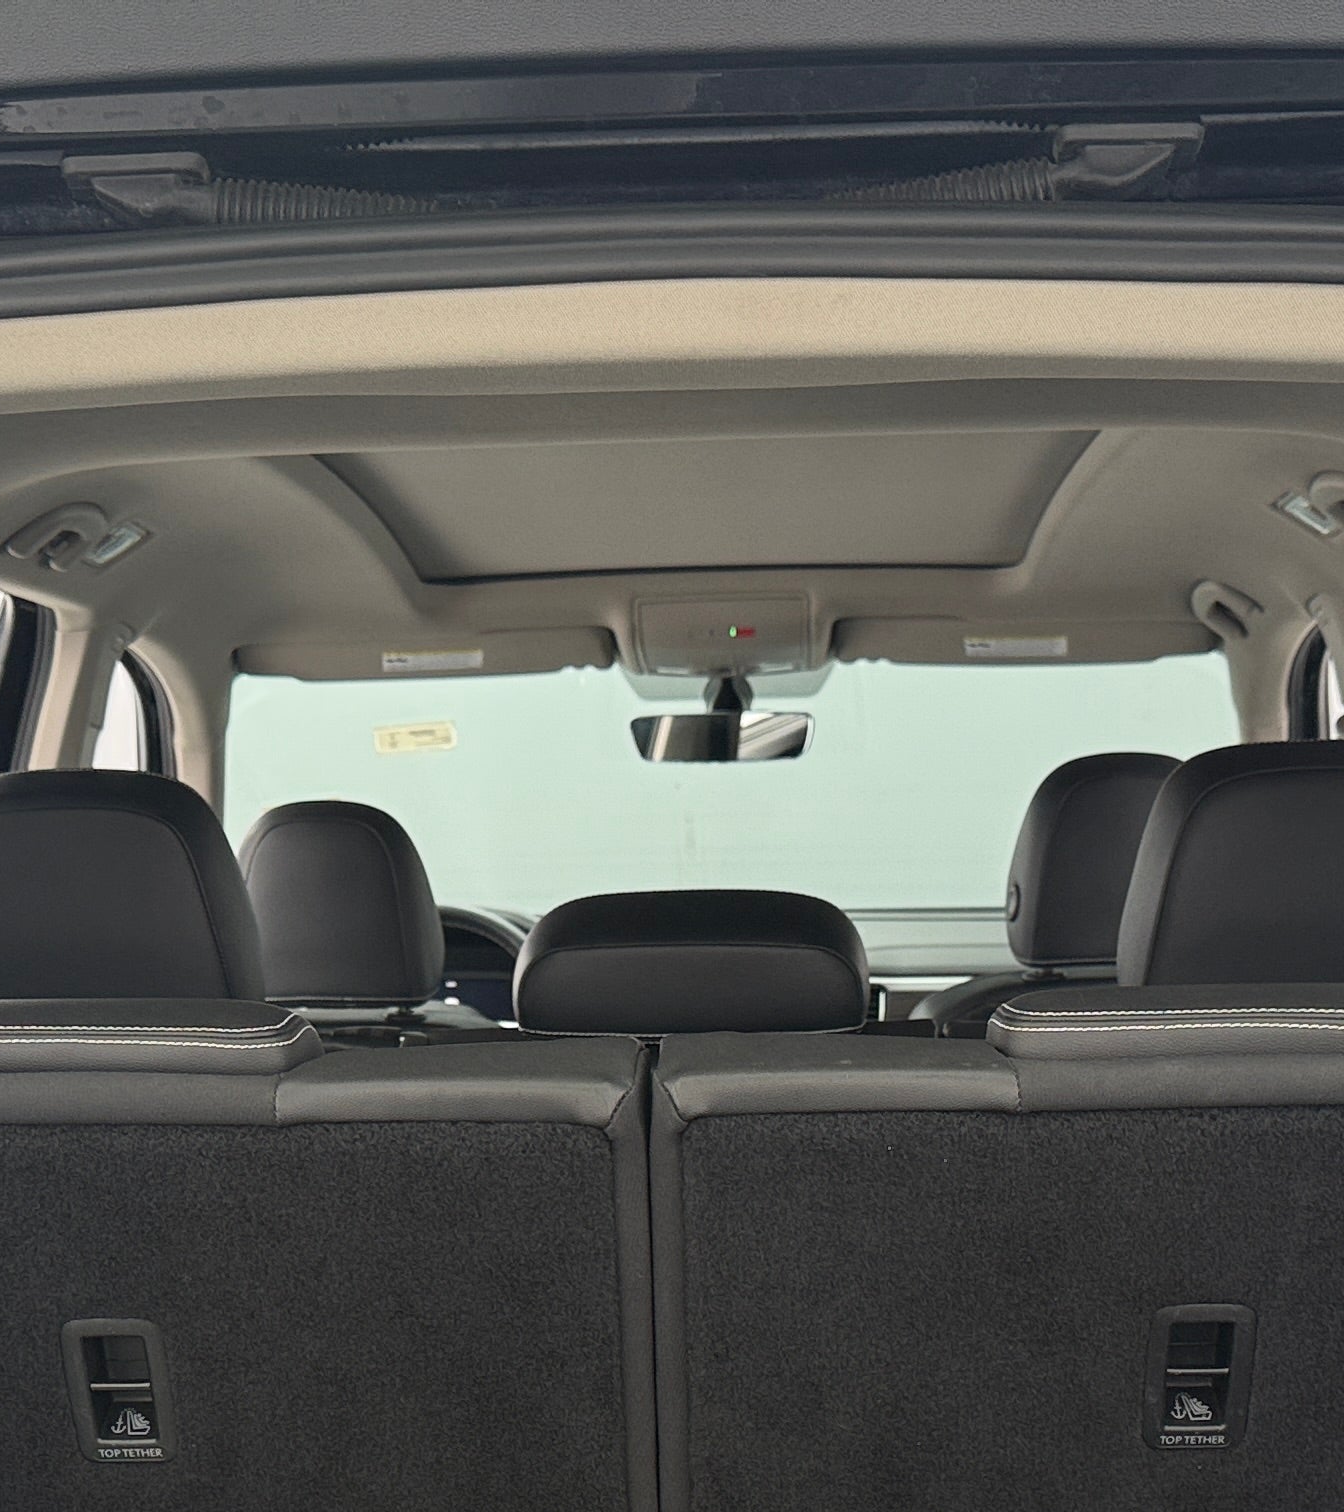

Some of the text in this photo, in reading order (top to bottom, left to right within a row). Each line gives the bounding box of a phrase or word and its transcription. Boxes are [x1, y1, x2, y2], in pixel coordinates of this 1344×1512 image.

[1160, 1435, 1225, 1445] TOP TETHER
[98, 1448, 164, 1458] TOP TETHER
